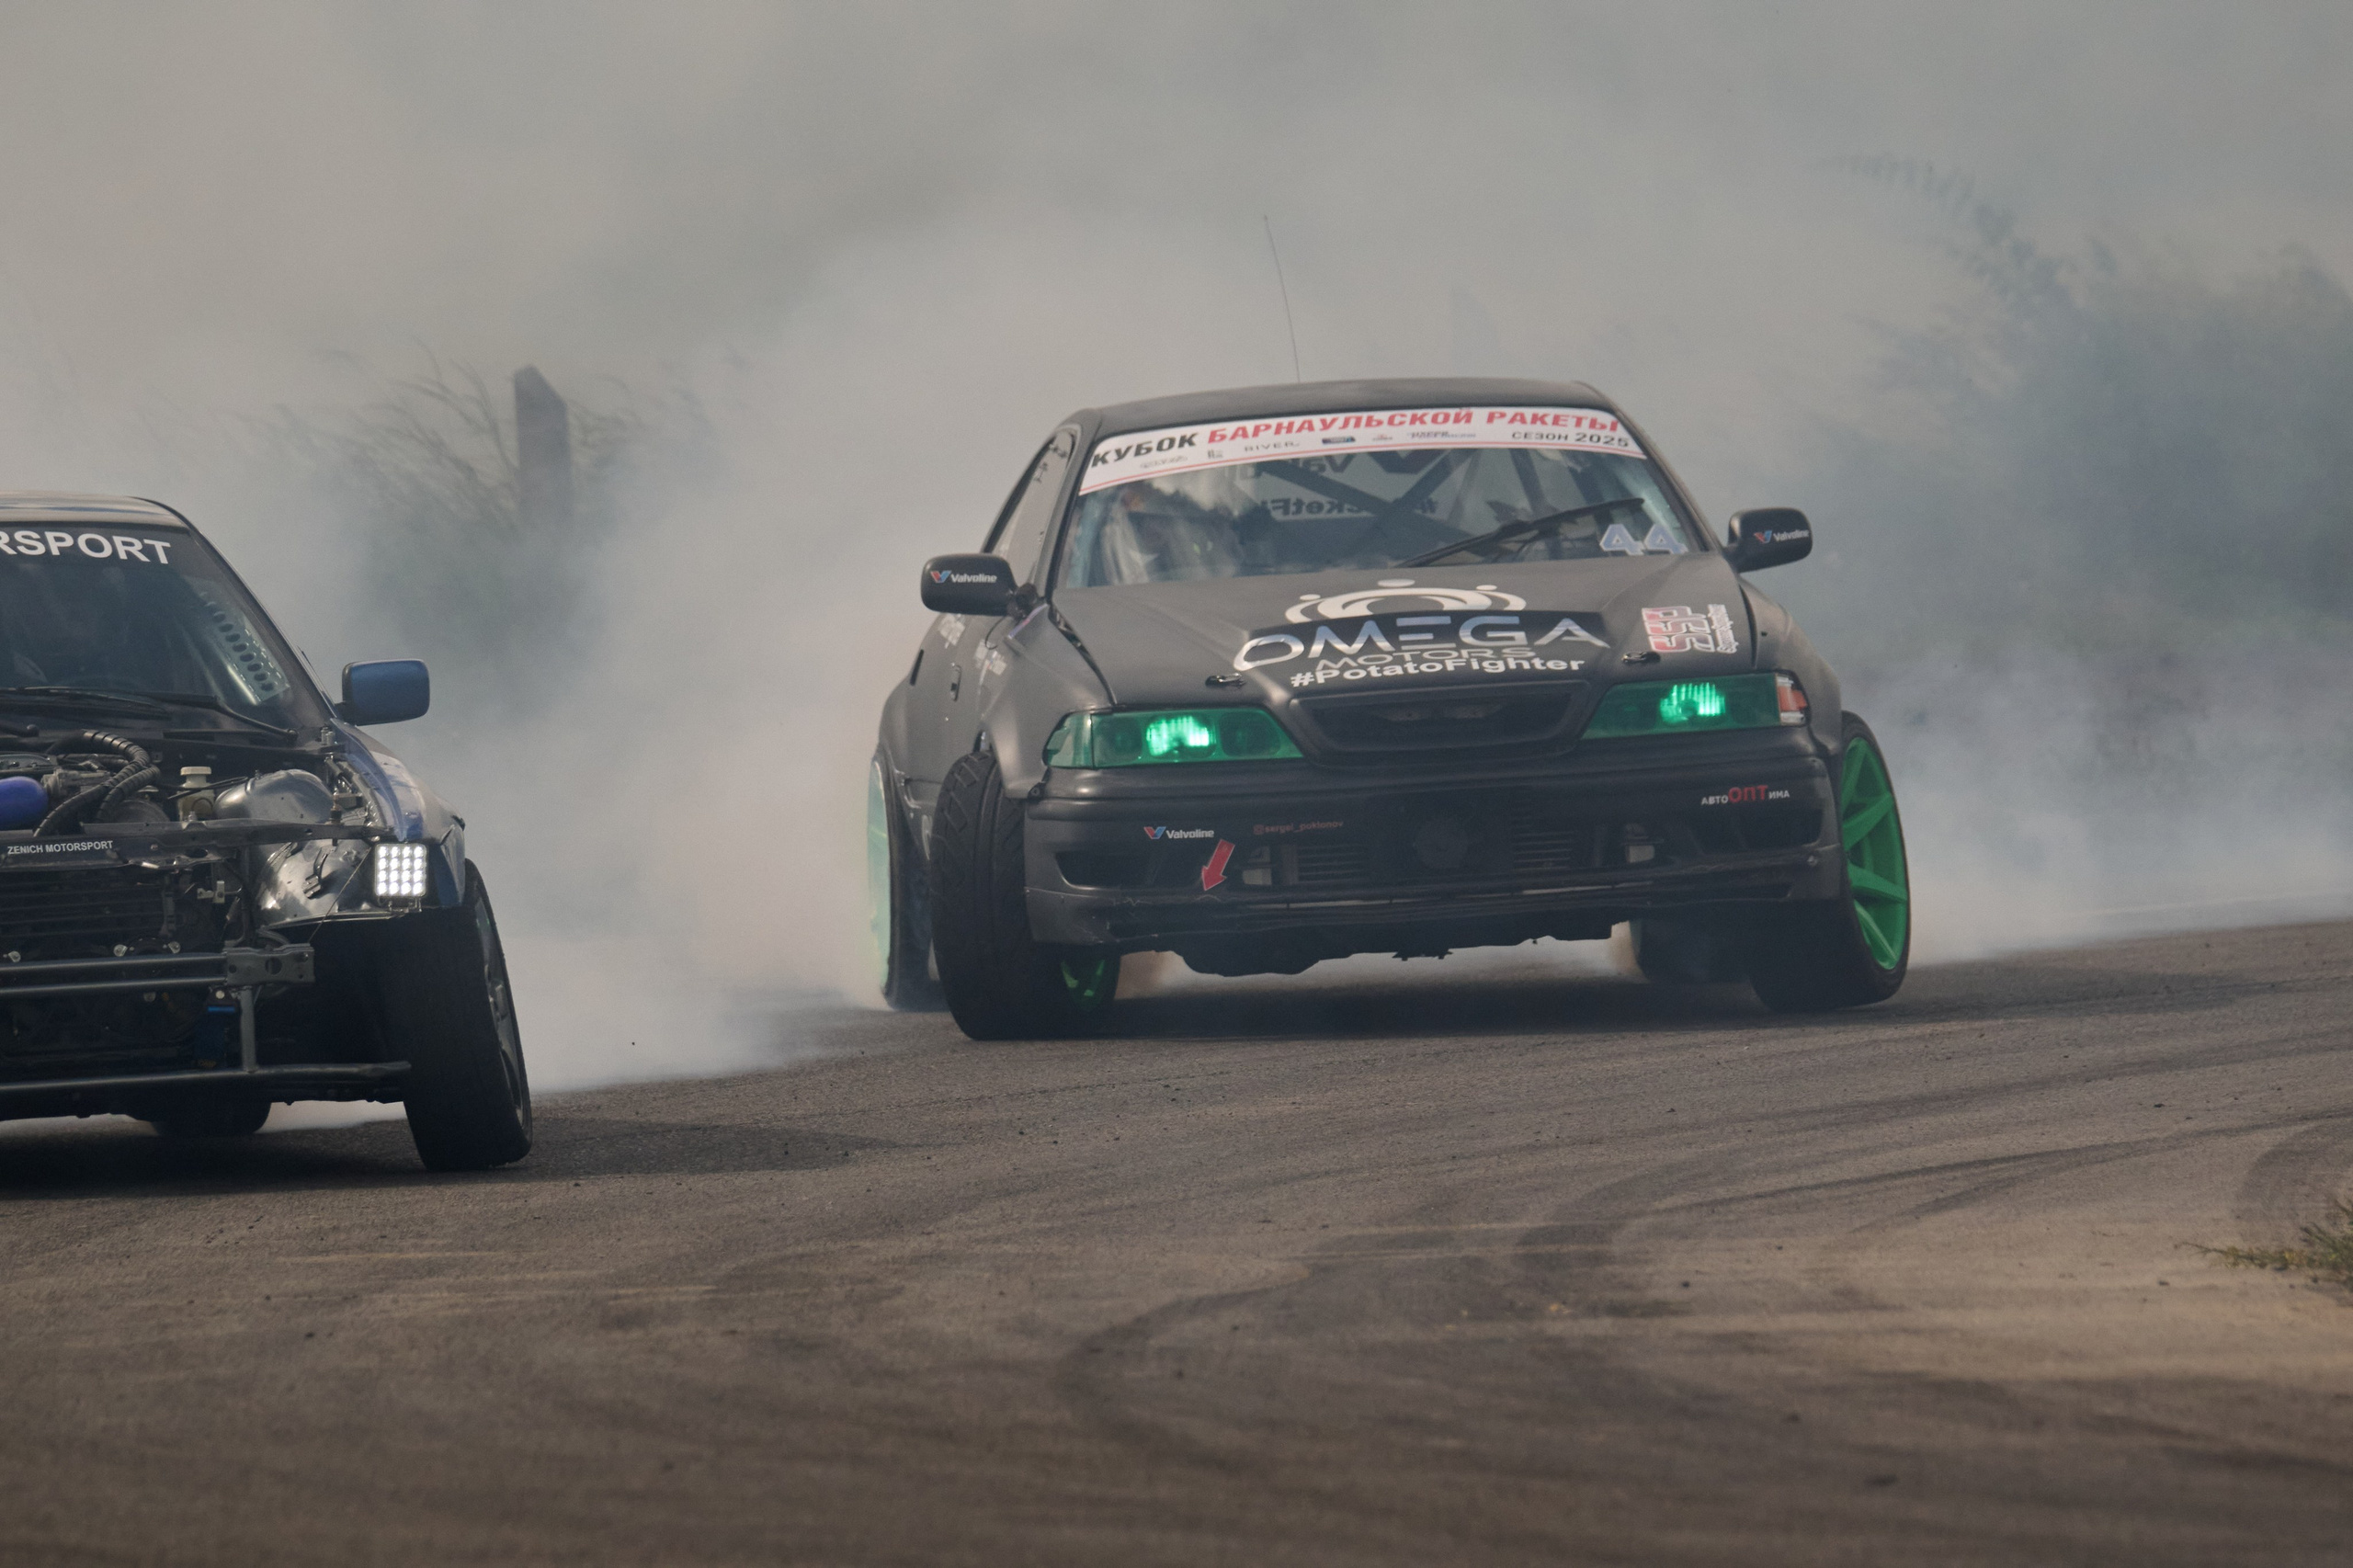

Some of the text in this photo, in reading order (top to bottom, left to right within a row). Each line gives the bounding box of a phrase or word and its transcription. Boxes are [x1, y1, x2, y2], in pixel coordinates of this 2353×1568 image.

[1091, 433, 1199, 468] КУБОК
[1208, 408, 1473, 444] БАРНАУЛЬСКОЙ
[1486, 411, 1619, 433] РАКЕТЫ
[1512, 431, 1630, 448] СЕЗОН 2025
[950, 573, 997, 583] Valvoline
[1233, 615, 1610, 672] OMEGA
[1316, 646, 1537, 671] MOTORS
[1290, 657, 1586, 687] #PotatoFighter
[1166, 828, 1215, 839] Valvoline
[7, 840, 113, 855] ZENICH MOTORSPORT
